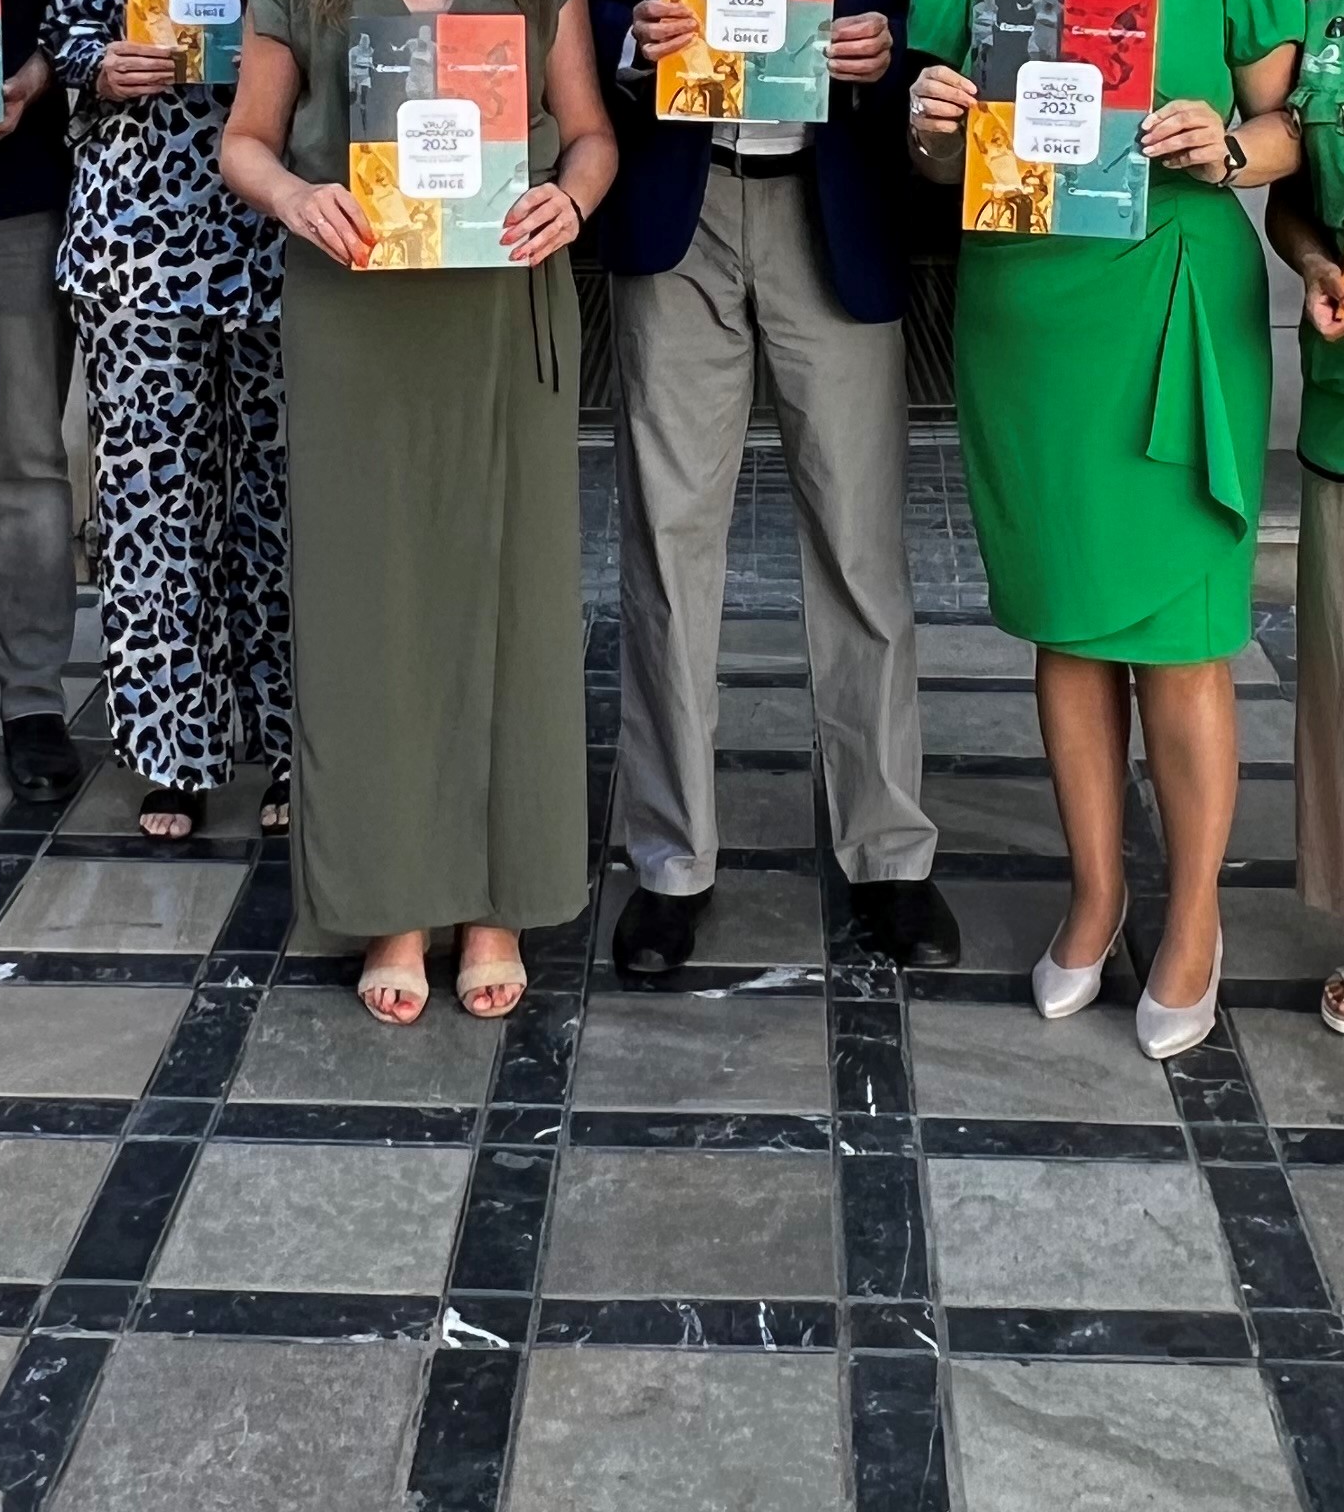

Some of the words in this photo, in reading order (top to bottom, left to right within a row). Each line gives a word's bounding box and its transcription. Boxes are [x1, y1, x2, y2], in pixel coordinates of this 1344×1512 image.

[1039, 102, 1076, 114] 2023
[422, 139, 457, 151] 2023
[1043, 144, 1080, 154] ONCE
[429, 179, 464, 189] ONCE
